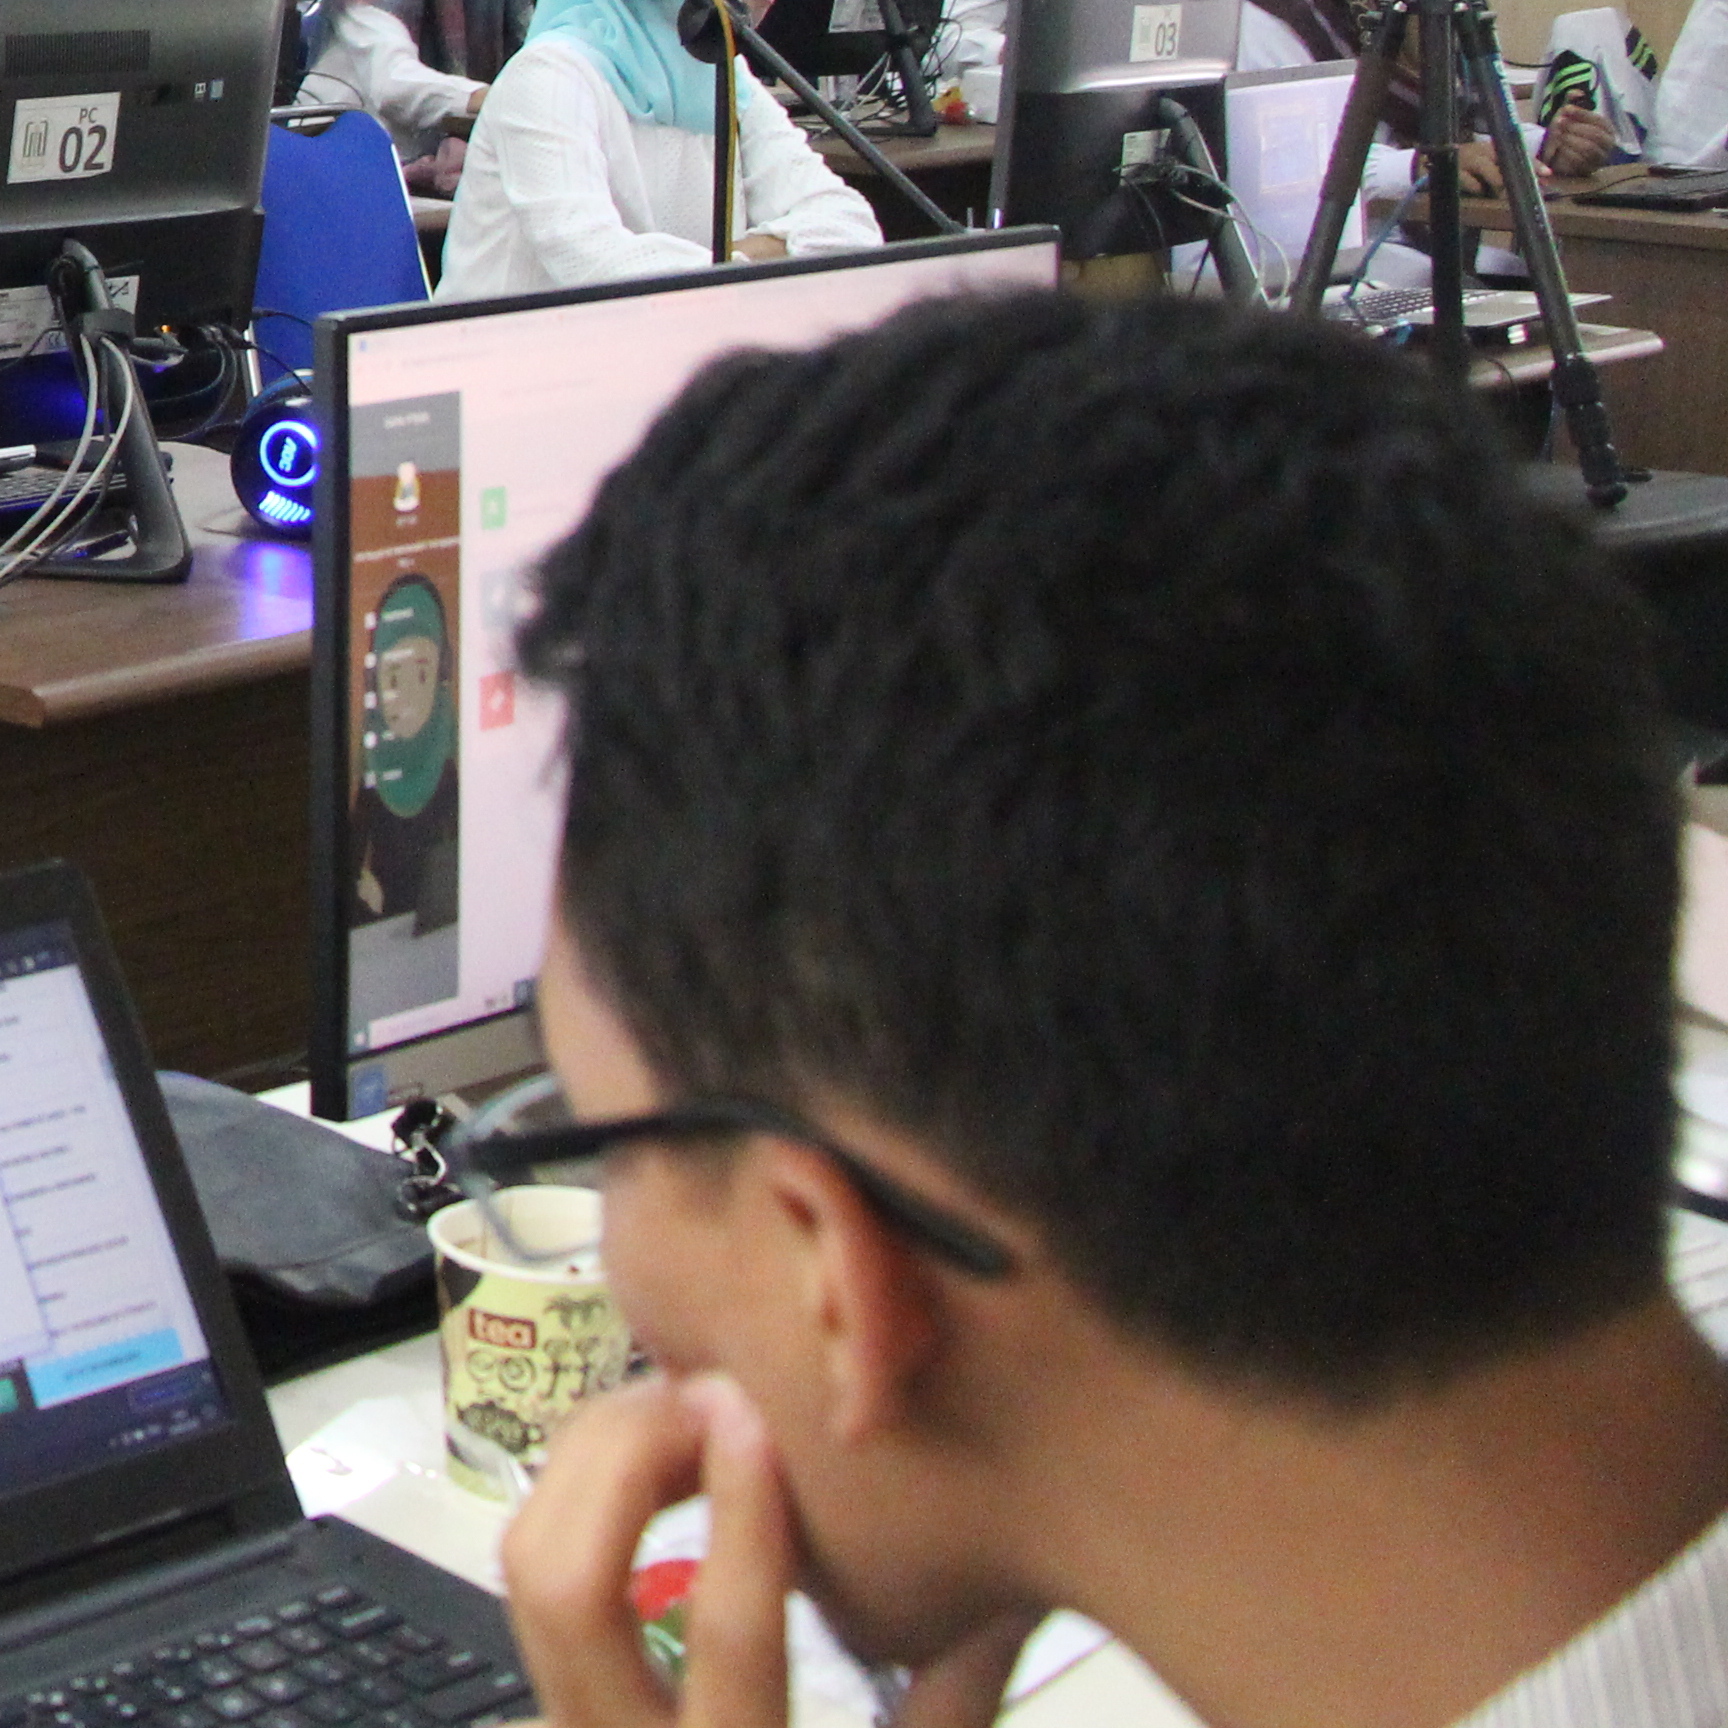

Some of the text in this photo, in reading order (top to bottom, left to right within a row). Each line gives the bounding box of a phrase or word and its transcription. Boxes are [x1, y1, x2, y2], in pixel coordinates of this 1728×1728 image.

[1155, 22, 1177, 56] 03
[79, 107, 99, 124] PC
[58, 125, 108, 173] 02
[475, 1310, 533, 1348] tea
